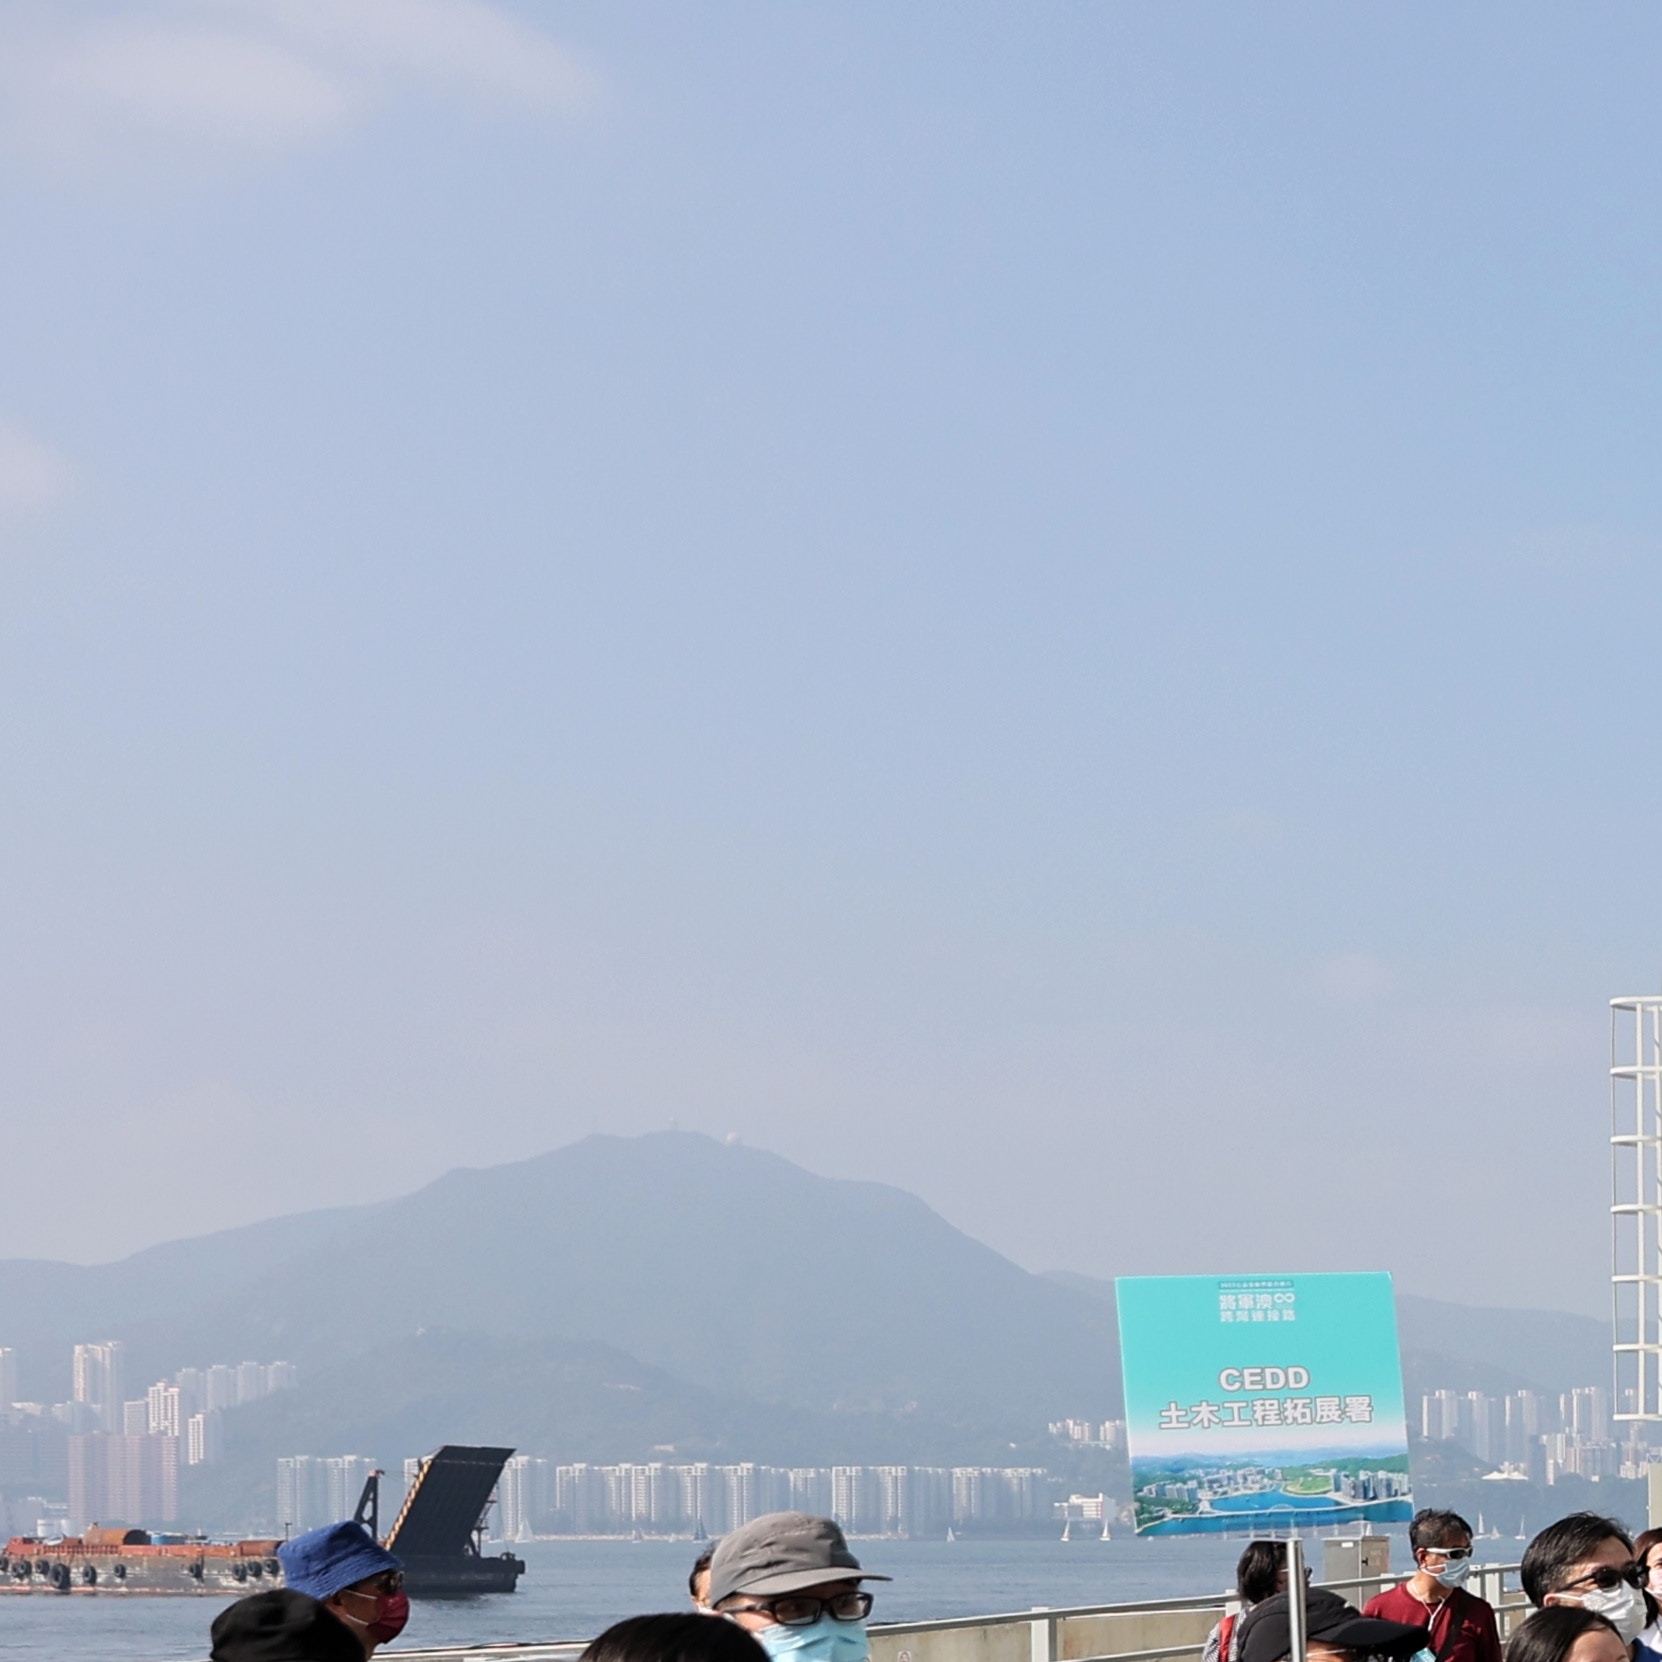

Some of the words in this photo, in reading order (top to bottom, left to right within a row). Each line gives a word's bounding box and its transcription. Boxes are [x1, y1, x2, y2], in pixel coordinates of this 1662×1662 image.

[1219, 1366, 1310, 1391] CEDD
[1159, 1395, 1374, 1429] 土木工程拓展署
